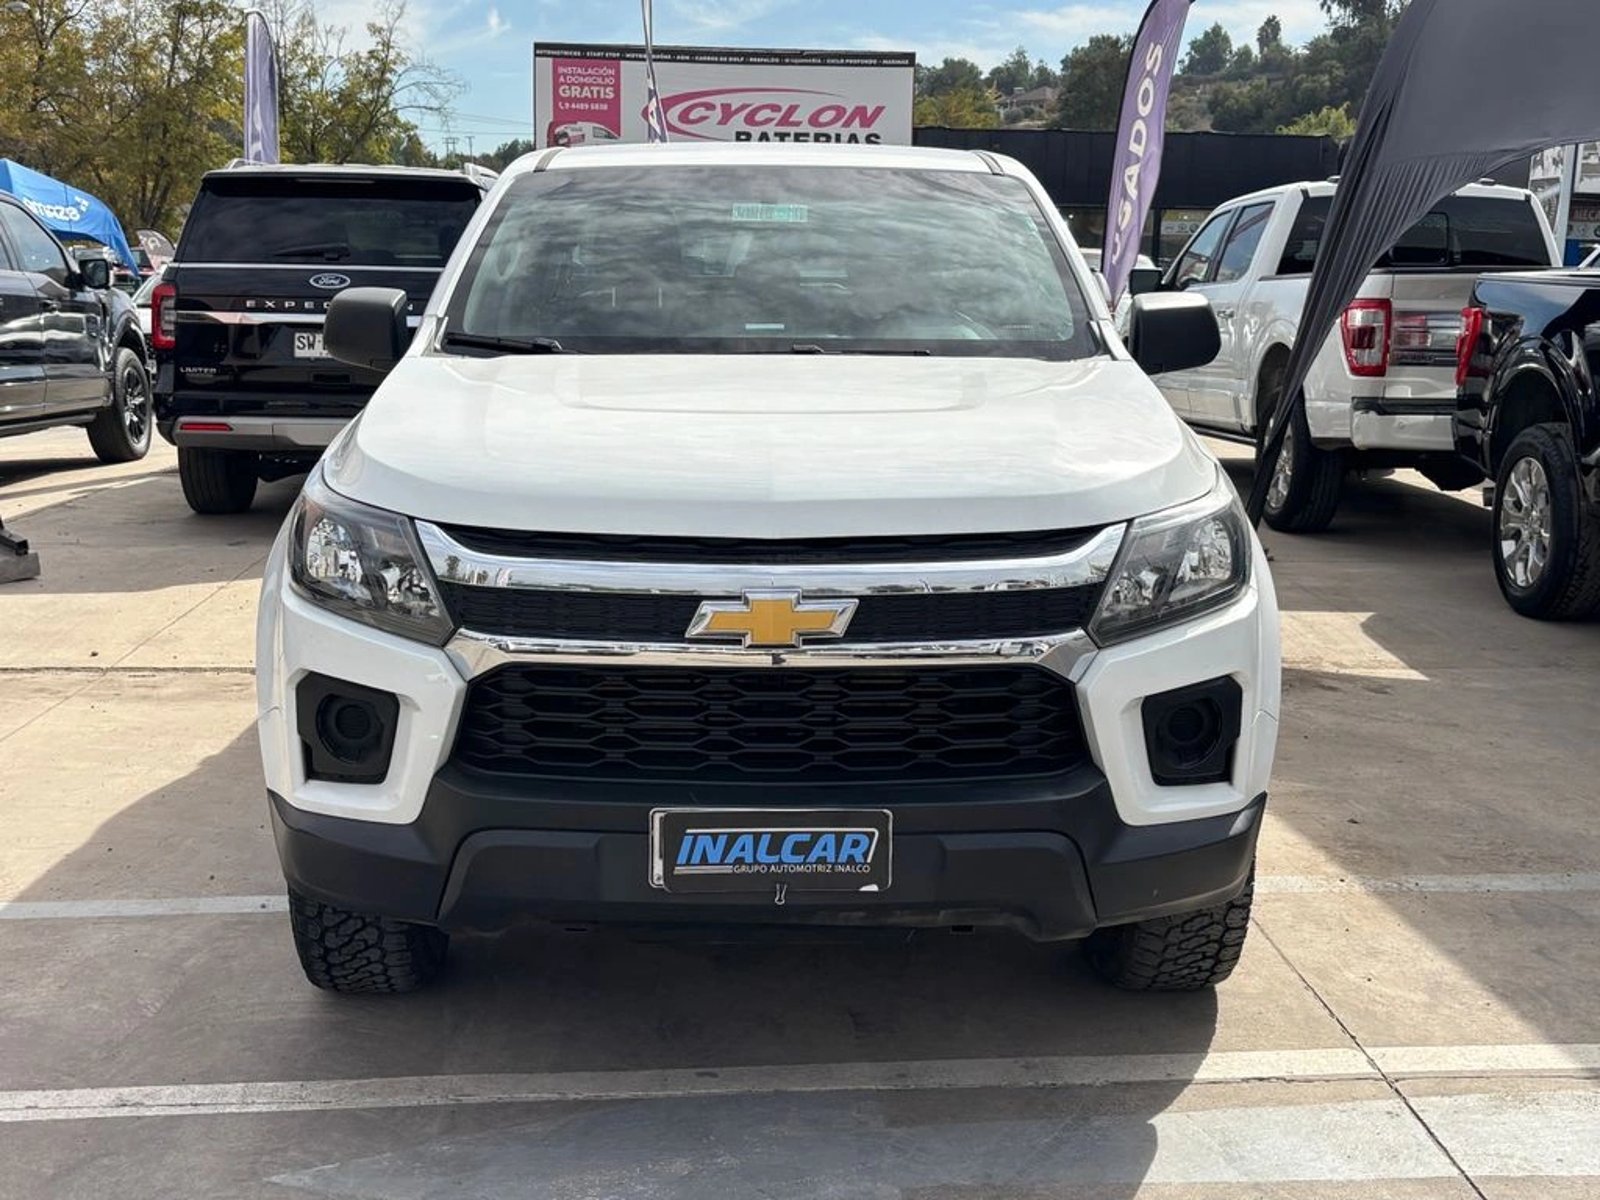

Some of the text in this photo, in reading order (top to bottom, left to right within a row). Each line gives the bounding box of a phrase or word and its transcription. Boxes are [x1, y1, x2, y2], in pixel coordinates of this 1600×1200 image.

[558, 66, 615, 76] INSTALACIÓN
[559, 76, 615, 85] A DOMICILIO
[558, 85, 615, 99] GRATIS
[677, 102, 886, 128] CYCLON
[735, 131, 882, 144] BATERIAS
[1112, 42, 1163, 265] USADOS
[676, 833, 871, 864] INALCAR
[733, 864, 871, 873] GRUPO AUTOMOTRIZ INALCO
